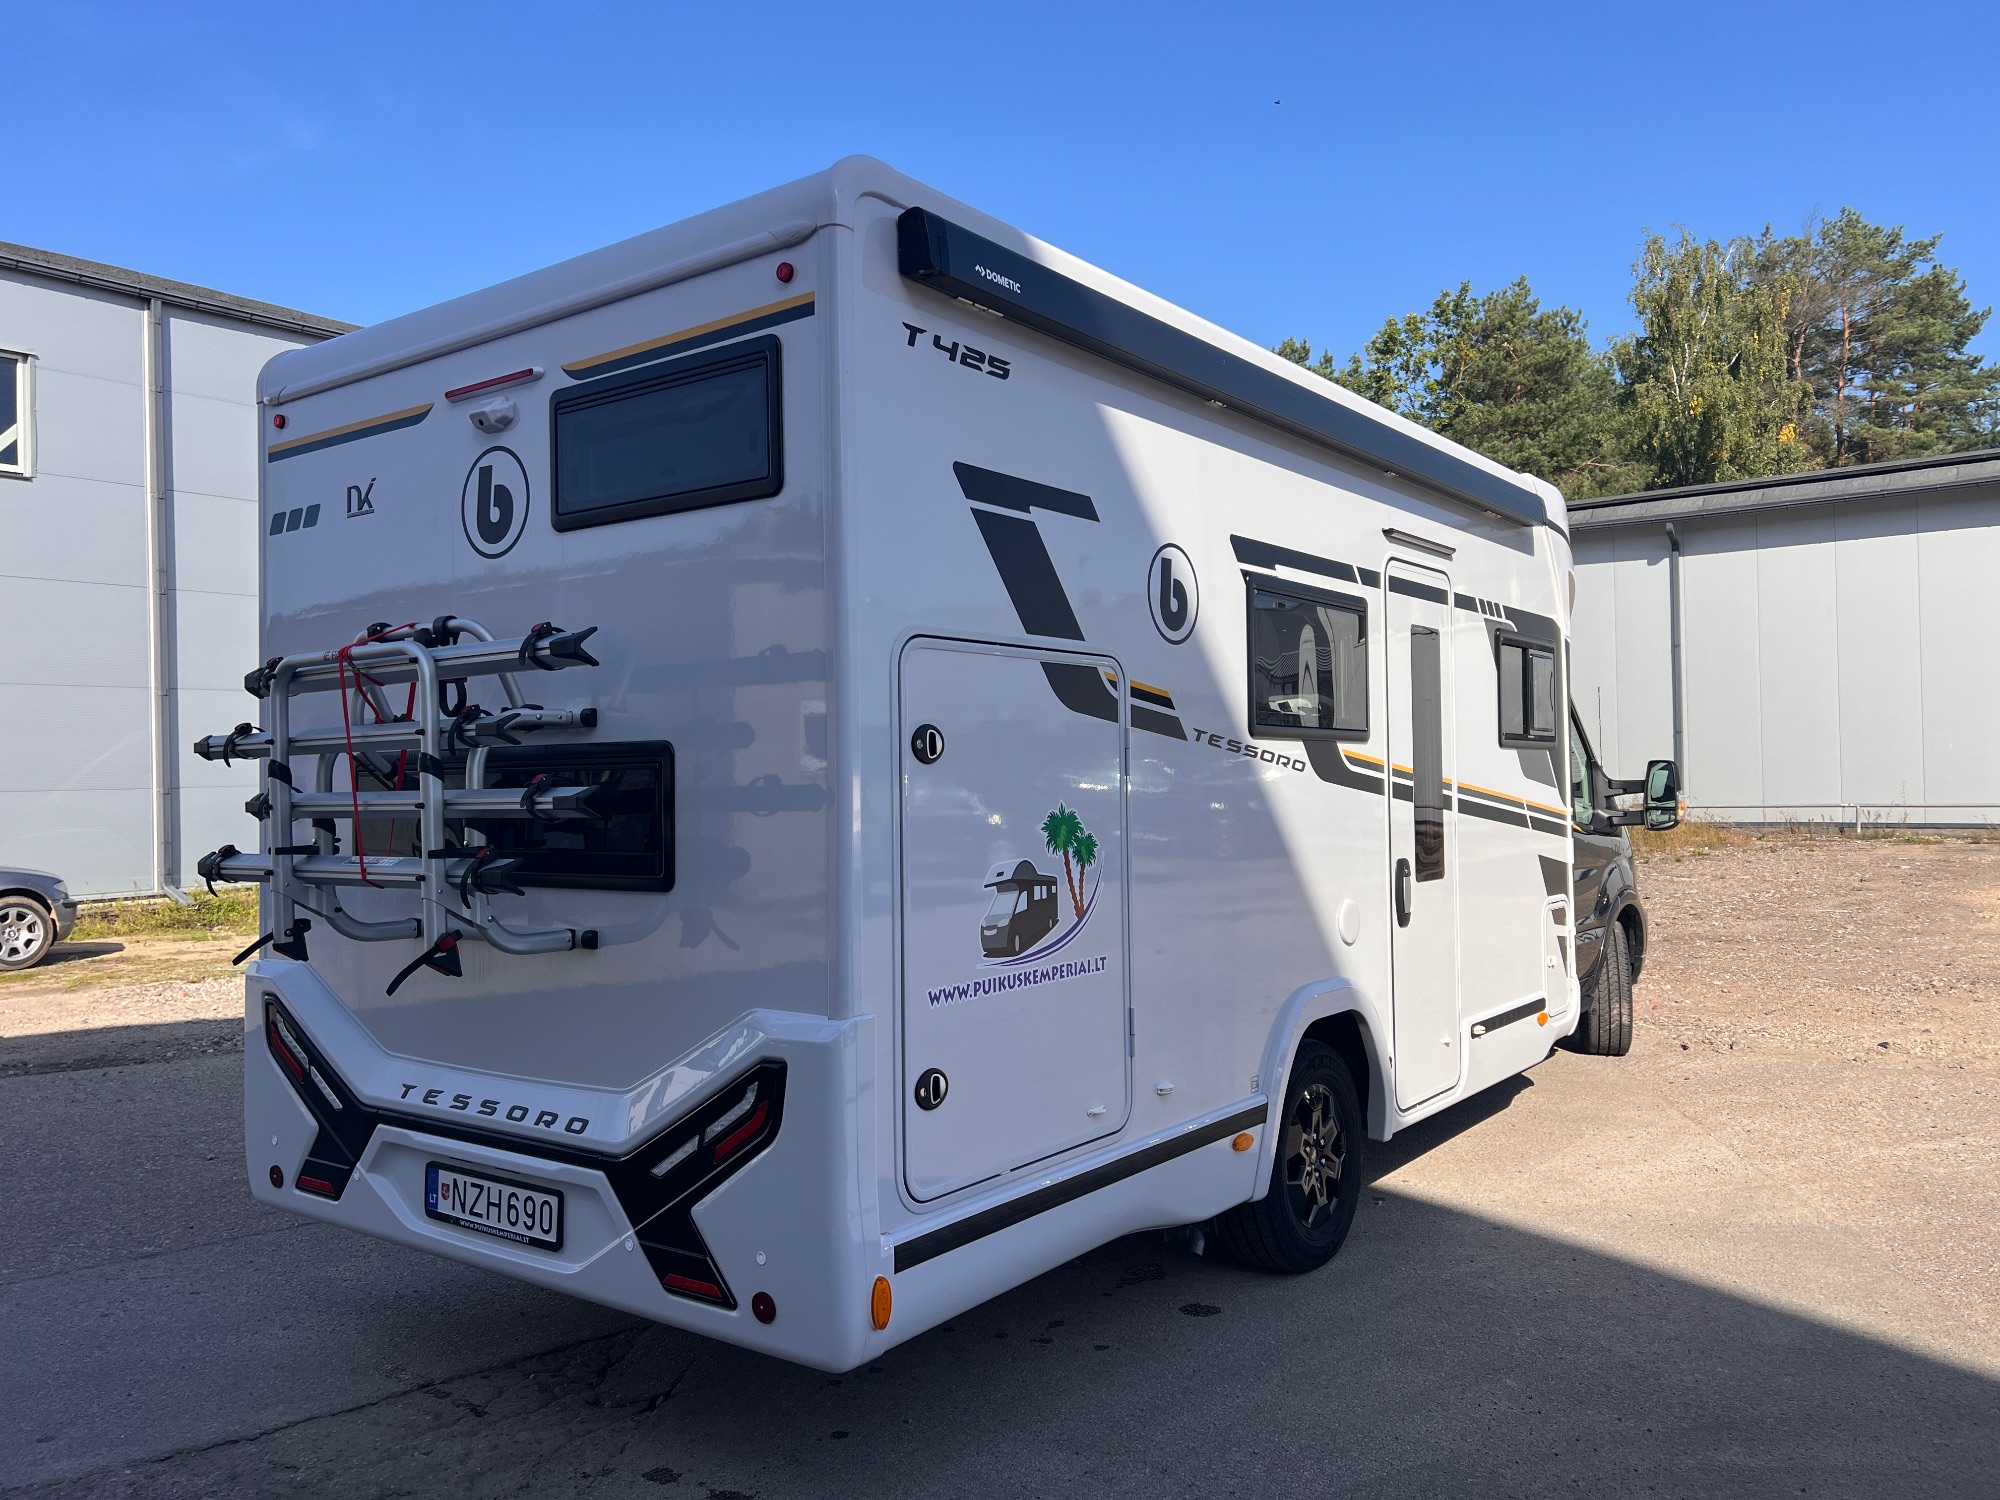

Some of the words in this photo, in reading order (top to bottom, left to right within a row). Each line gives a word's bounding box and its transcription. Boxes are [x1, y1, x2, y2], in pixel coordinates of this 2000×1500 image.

[986, 269, 1021, 294] DOMETIC
[902, 321, 928, 347] T
[932, 334, 1012, 380] 425
[1192, 727, 1307, 773] TESSORO
[927, 956, 1107, 1008] WWW.PUIKUSKEMPERIAI.LT
[400, 1083, 590, 1135] TESSORO
[429, 1192, 438, 1204] LT
